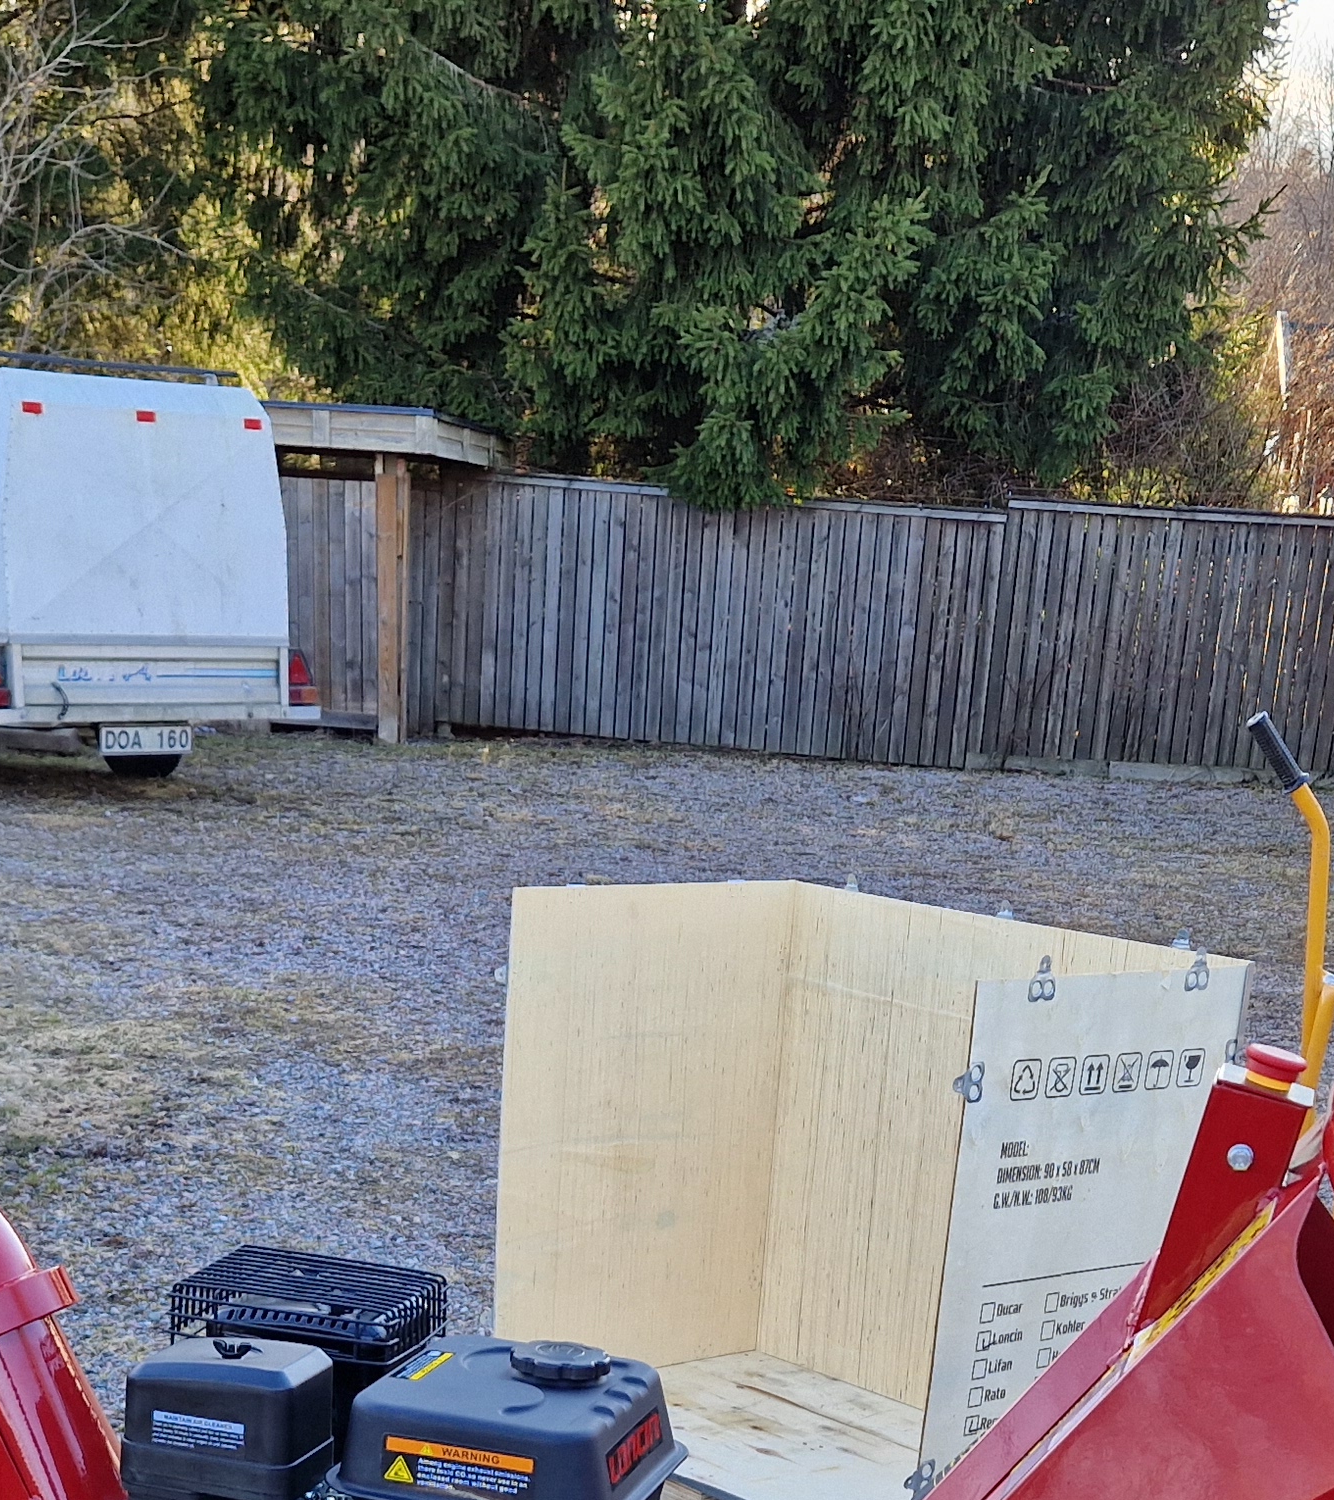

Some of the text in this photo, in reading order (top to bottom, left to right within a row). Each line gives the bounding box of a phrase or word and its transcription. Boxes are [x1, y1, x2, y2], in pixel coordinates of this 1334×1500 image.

[105, 729, 189, 749] DOA 160
[1000, 1140, 1029, 1159] MODEL:
[996, 1164, 1042, 1184] DIMENSION:
[1043, 1162, 1055, 1179] 90
[1061, 1160, 1073, 1177] 58
[1078, 1157, 1101, 1175] 87CM
[1034, 1184, 1073, 1204] 108/93KG
[1060, 1292, 1089, 1308] Briggs
[996, 1303, 1024, 1317] Ducar
[1056, 1319, 1086, 1335] Kohler
[992, 1328, 1023, 1345] Loncin
[988, 1358, 1013, 1374] Lifan
[984, 1387, 1006, 1402] Rato
[441, 1447, 501, 1465] WARNING
[443, 1462, 466, 1471] engine
[467, 1464, 494, 1476] exhaust
[417, 1472, 450, 1482] enclosed
[451, 1477, 470, 1486] room
[470, 1480, 498, 1491] without
[477, 1474, 497, 1483] never
